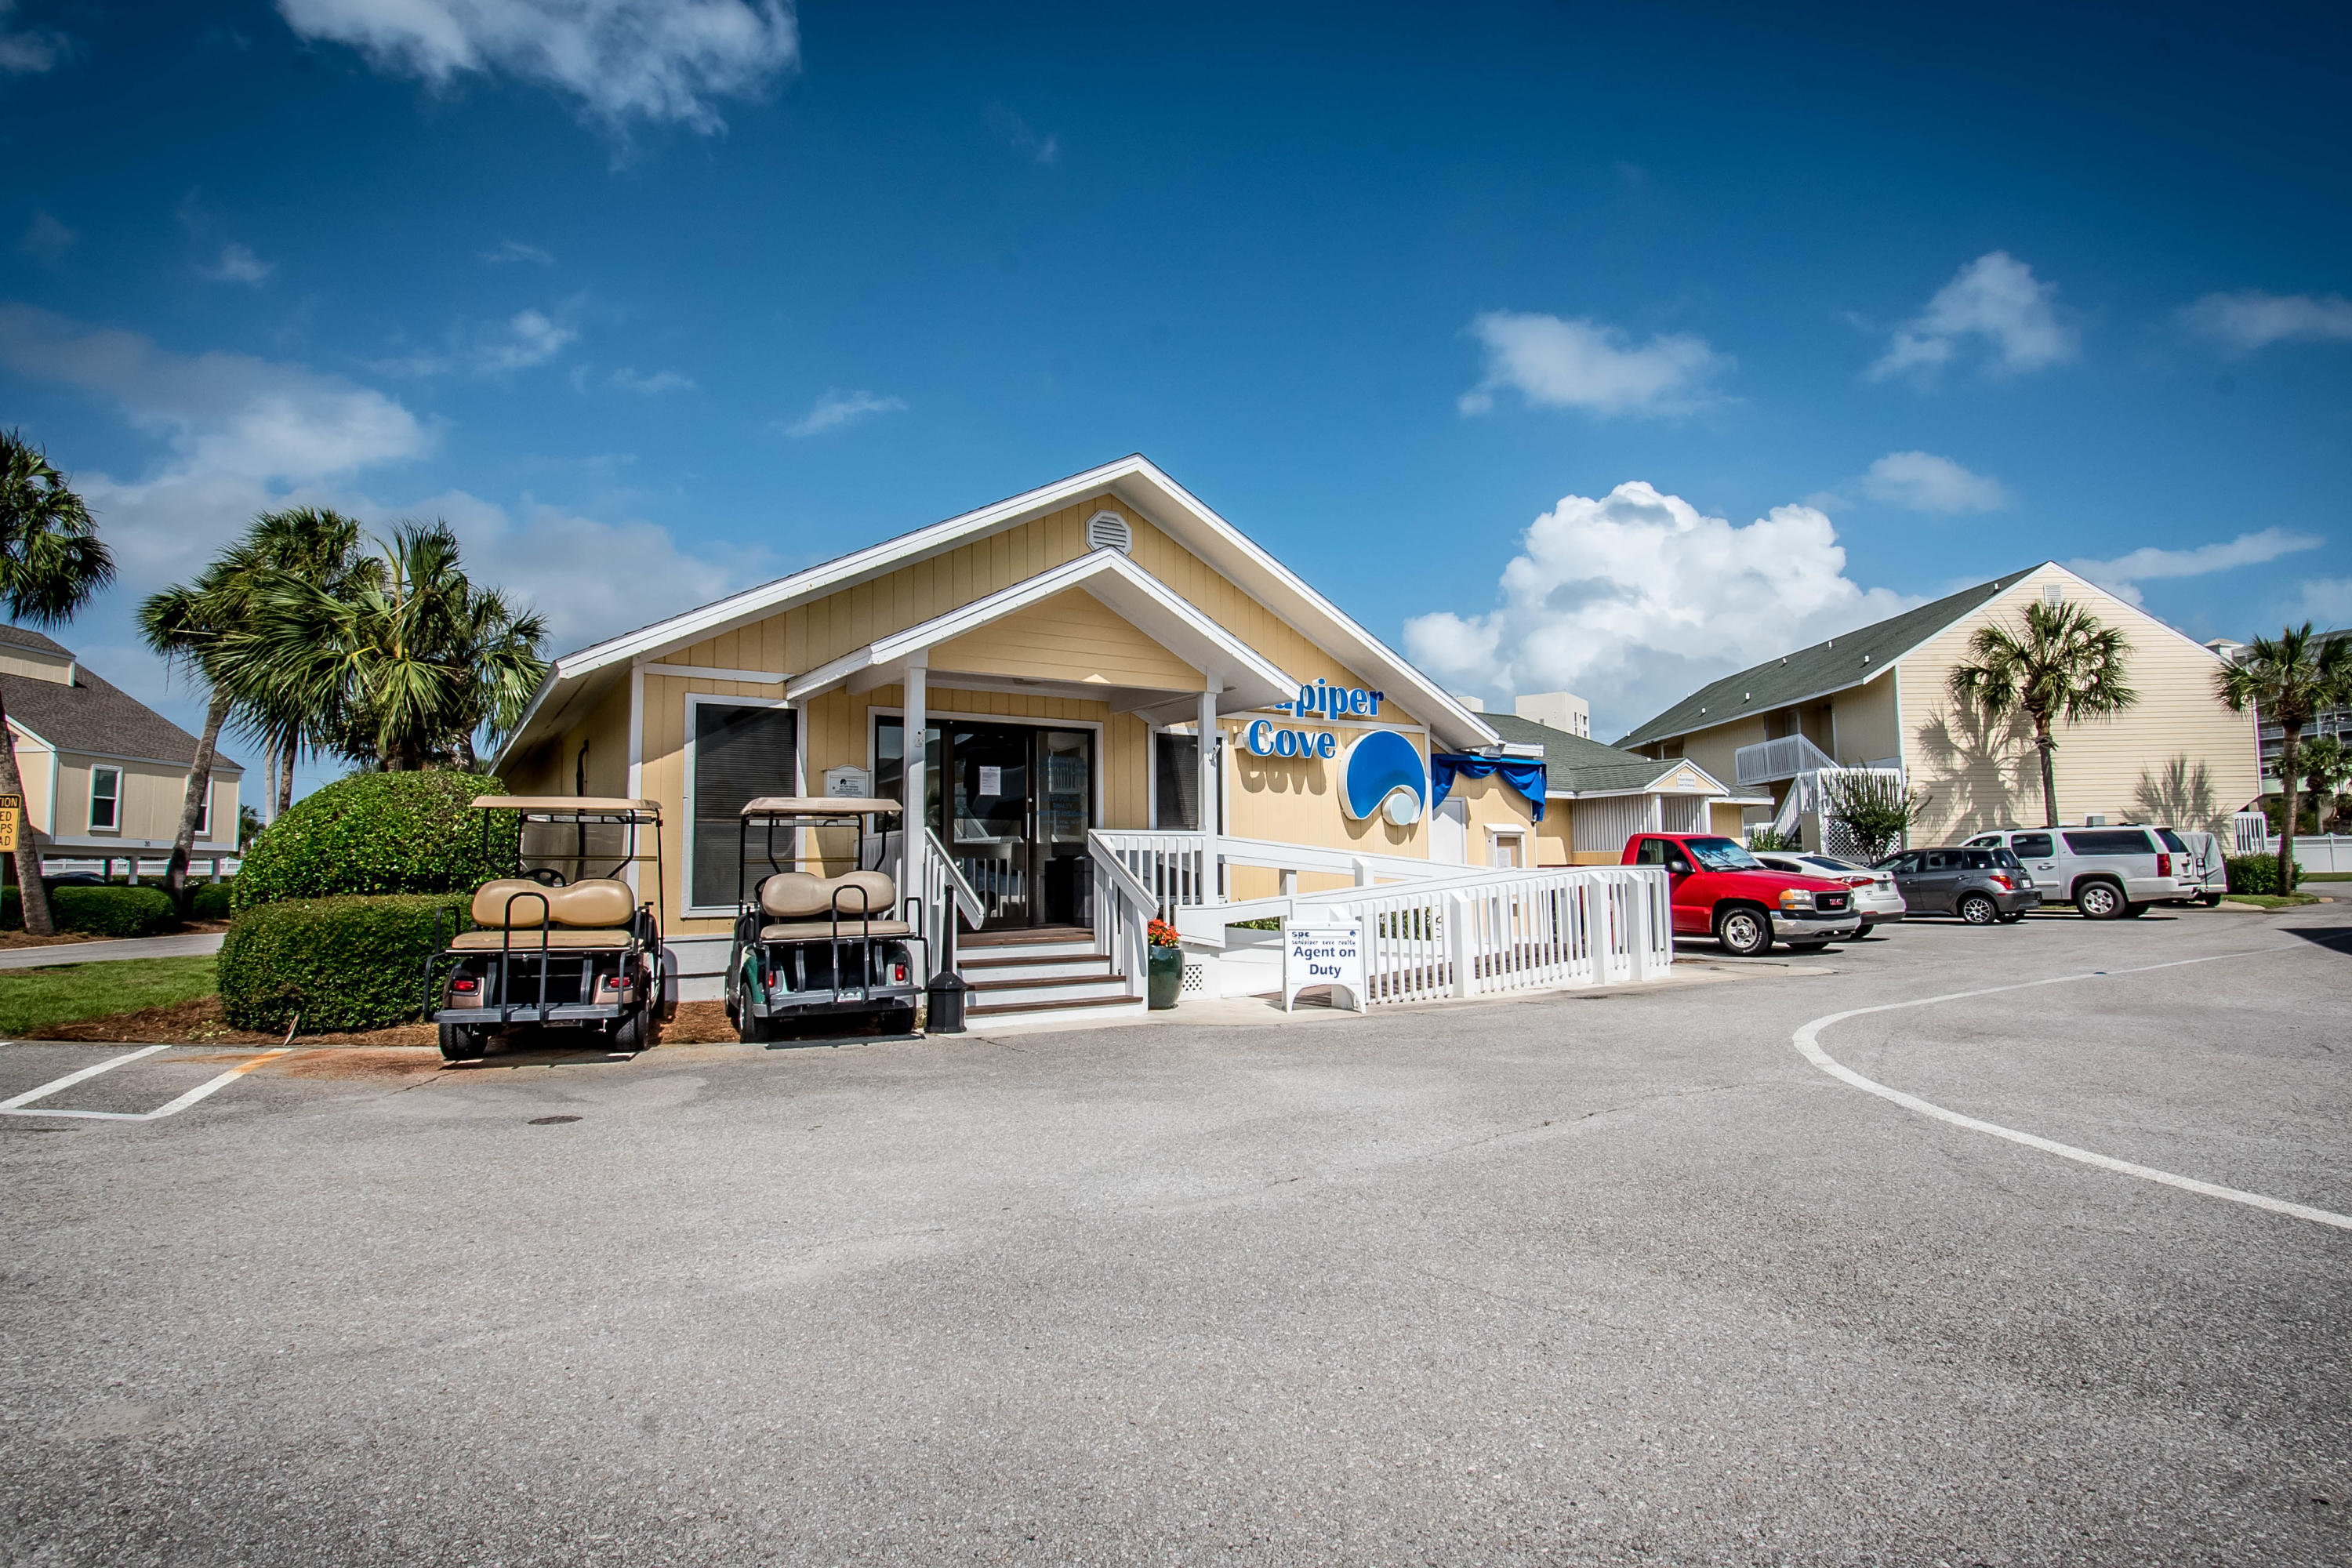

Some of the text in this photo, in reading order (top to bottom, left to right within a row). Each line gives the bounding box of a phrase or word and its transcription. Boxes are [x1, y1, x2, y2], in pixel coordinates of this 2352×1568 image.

[1274, 677, 1385, 720] piper
[1248, 719, 1336, 759] Cove
[0, 797, 18, 807] ION
[1294, 946, 1356, 960] Agent on
[1309, 964, 1341, 978] Duty
